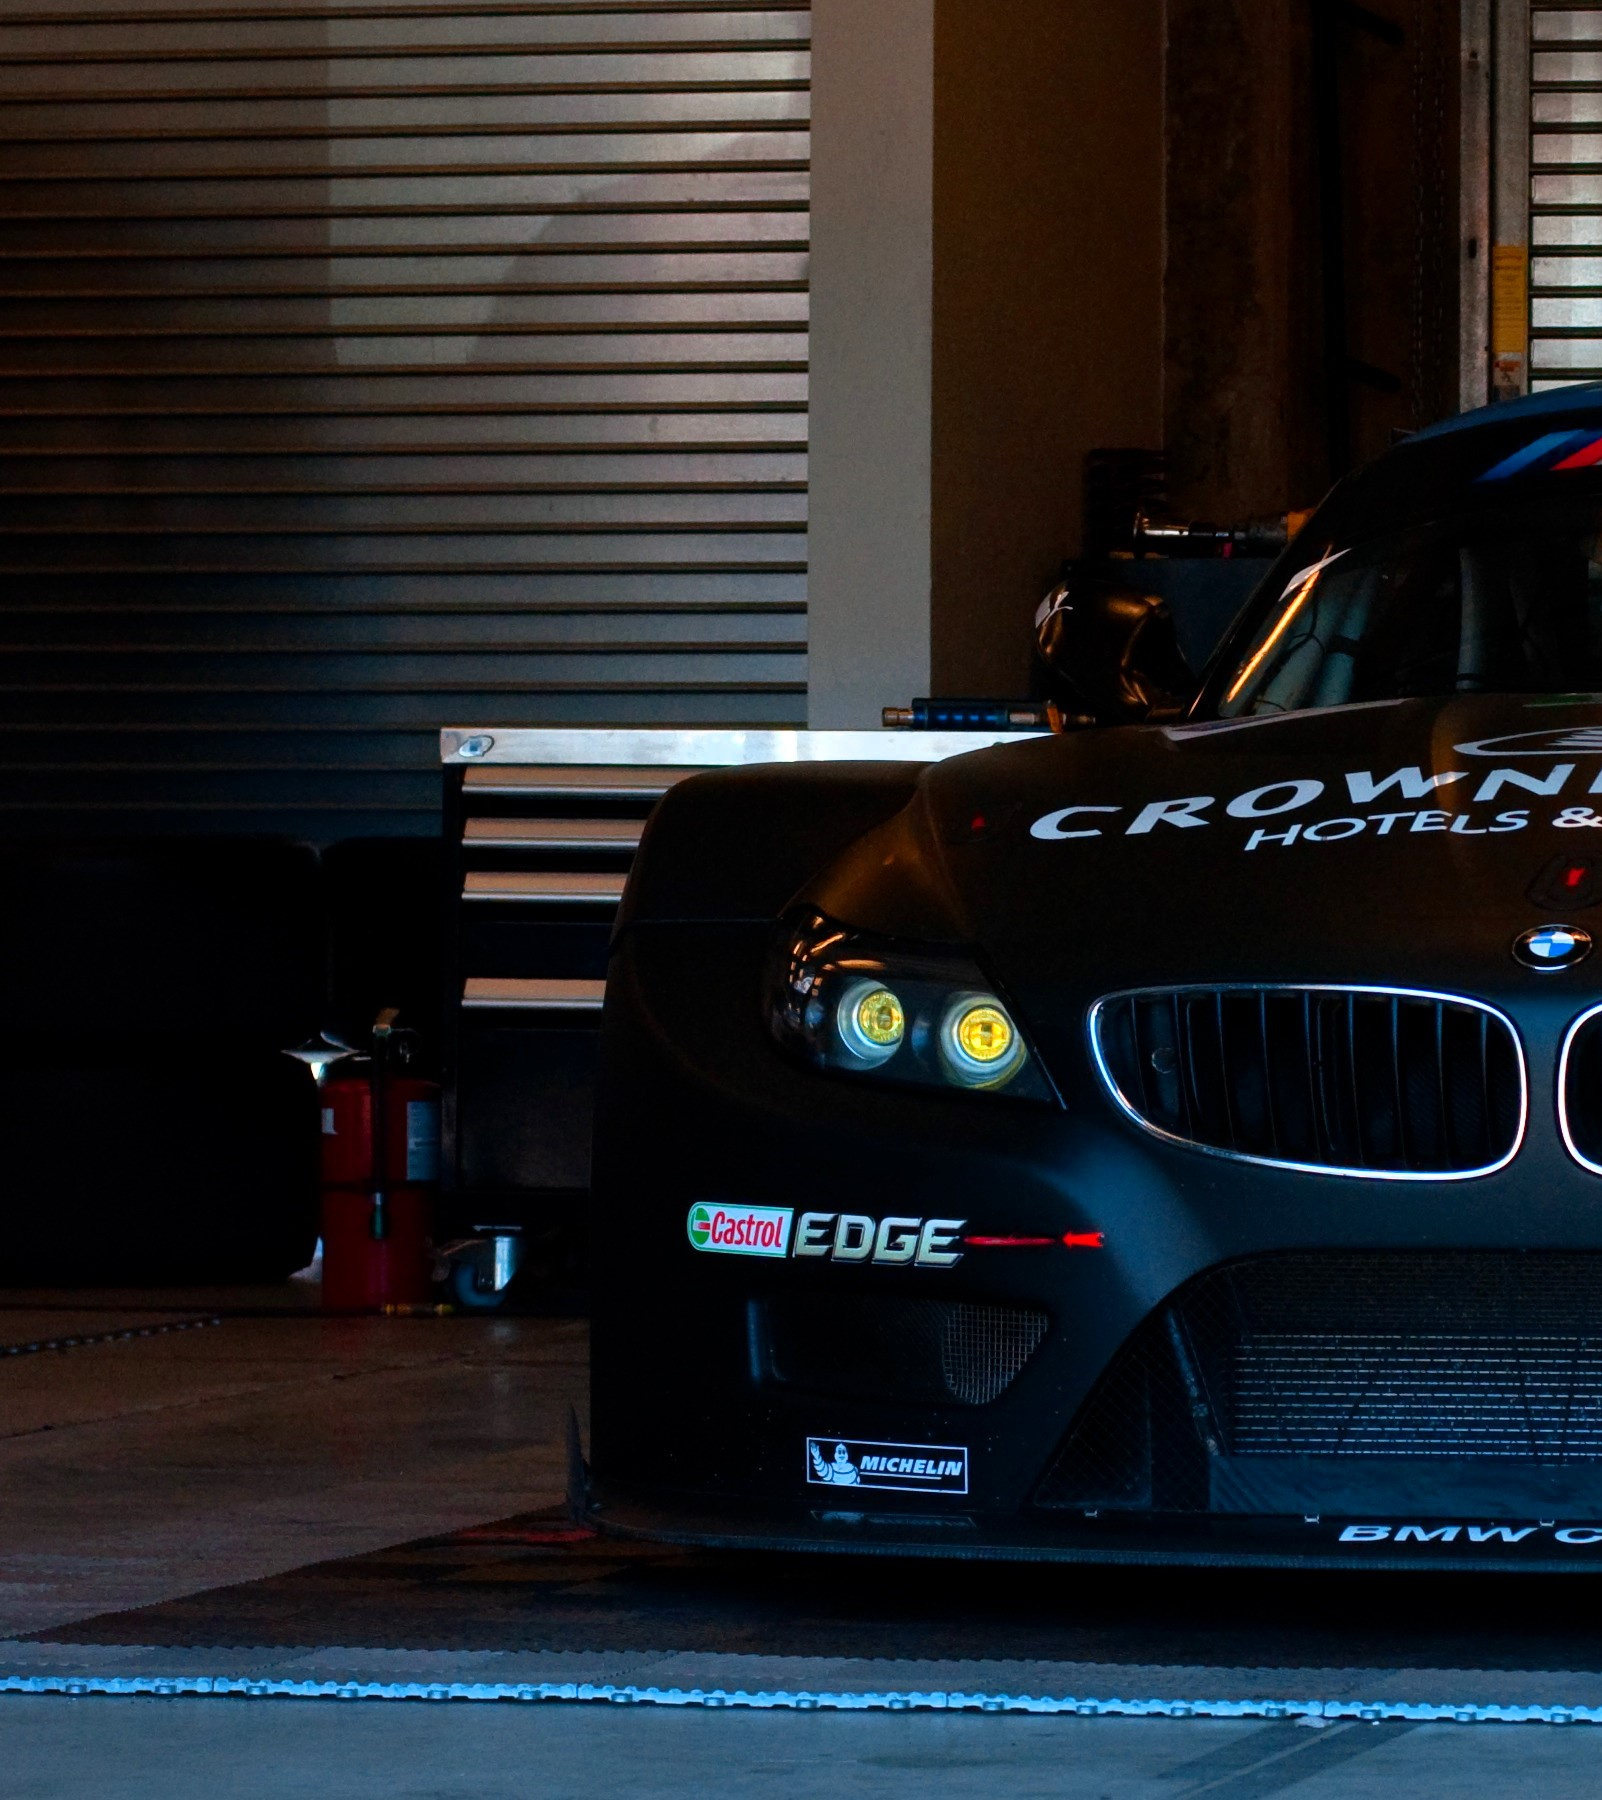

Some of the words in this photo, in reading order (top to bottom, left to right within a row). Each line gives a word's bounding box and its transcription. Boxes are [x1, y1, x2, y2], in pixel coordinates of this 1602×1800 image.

[1243, 808, 1530, 852] HOTELS
[711, 1210, 784, 1248] Castrol
[792, 1211, 969, 1269] EDGE
[859, 1455, 963, 1477] MICHELIN
[1338, 1524, 1537, 1544] BMW
